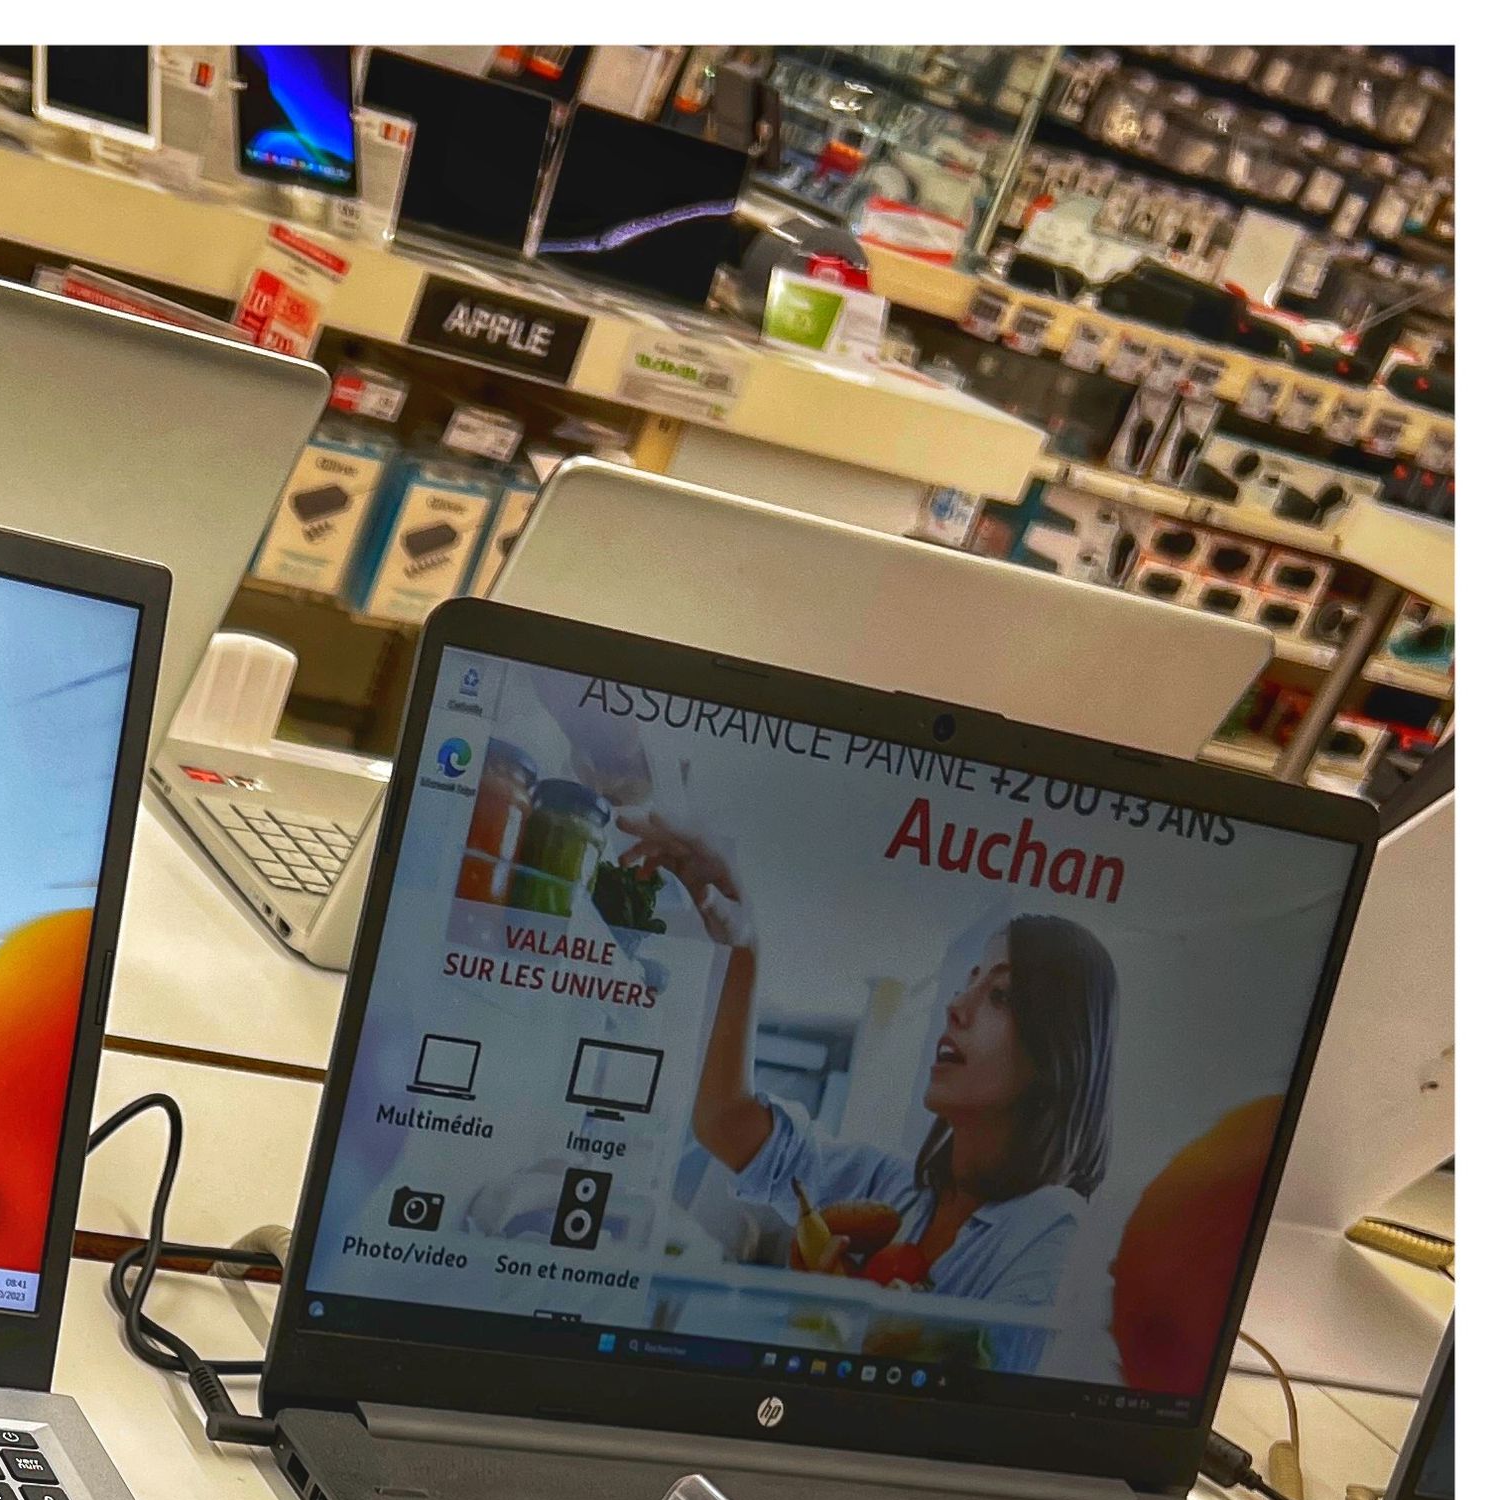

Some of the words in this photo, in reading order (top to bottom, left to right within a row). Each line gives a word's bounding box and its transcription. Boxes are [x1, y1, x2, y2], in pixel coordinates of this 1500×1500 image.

[442, 299, 556, 358] APPLE
[579, 677, 832, 761] ASSURANCE
[844, 735, 978, 793] PANNE
[1156, 805, 1236, 847] ANS
[883, 797, 1125, 904] Auchan
[504, 925, 617, 966] VALABLE
[443, 951, 494, 983] SUR
[499, 961, 544, 991] LES
[551, 970, 659, 1010] UNIVERS
[375, 1103, 494, 1139] Multimédia
[565, 1130, 627, 1159] Image
[341, 1235, 468, 1270] Photo/video
[5, 1277, 27, 1289] 08:41
[494, 1254, 533, 1278] Son
[537, 1261, 557, 1281] et
[561, 1264, 640, 1291] nomade
[758, 1396, 785, 1429] hp
